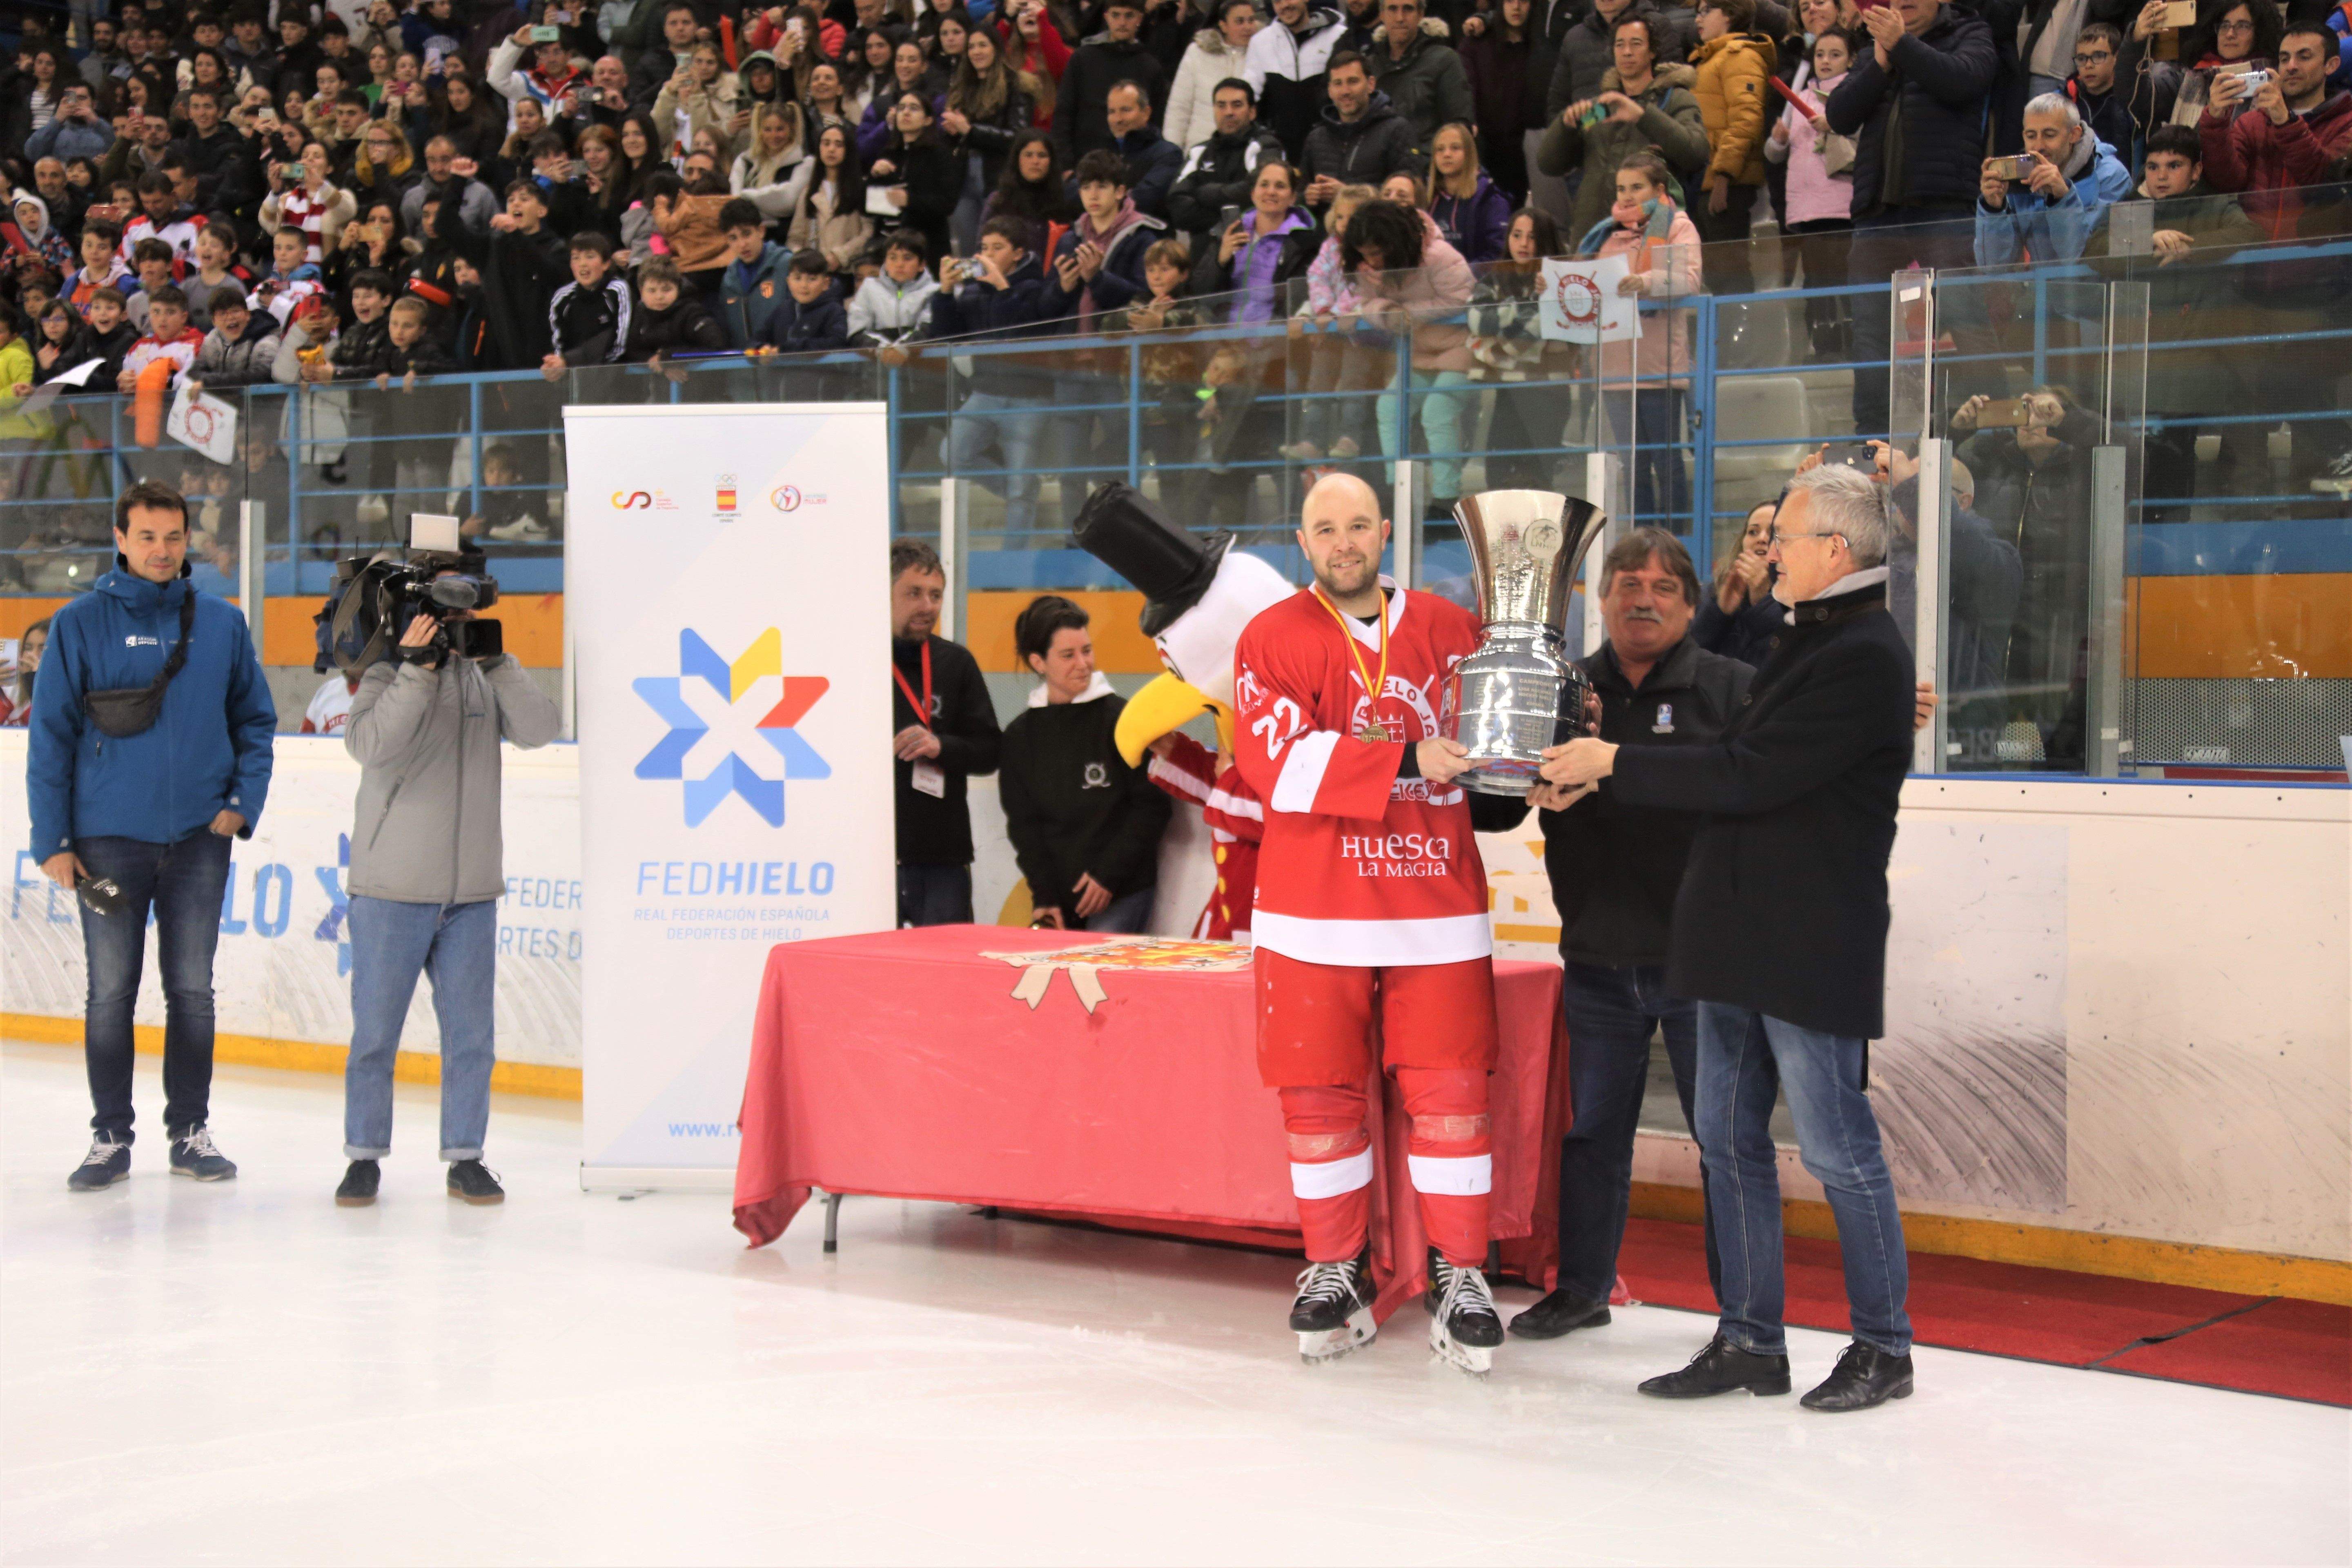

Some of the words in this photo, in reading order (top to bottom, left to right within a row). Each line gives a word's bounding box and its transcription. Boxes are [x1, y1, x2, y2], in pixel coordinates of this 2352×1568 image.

[1252, 697, 1307, 761] 22
[637, 861, 834, 895] FEDHIELO
[634, 909, 668, 921] REAL
[672, 906, 755, 921] FEDERACIÓN
[760, 906, 829, 921] ESPAÑOLA
[667, 928, 736, 940] DEPORTES
[741, 928, 758, 940] DE
[762, 928, 802, 940] HIELO
[668, 1124, 742, 1137] www.r
